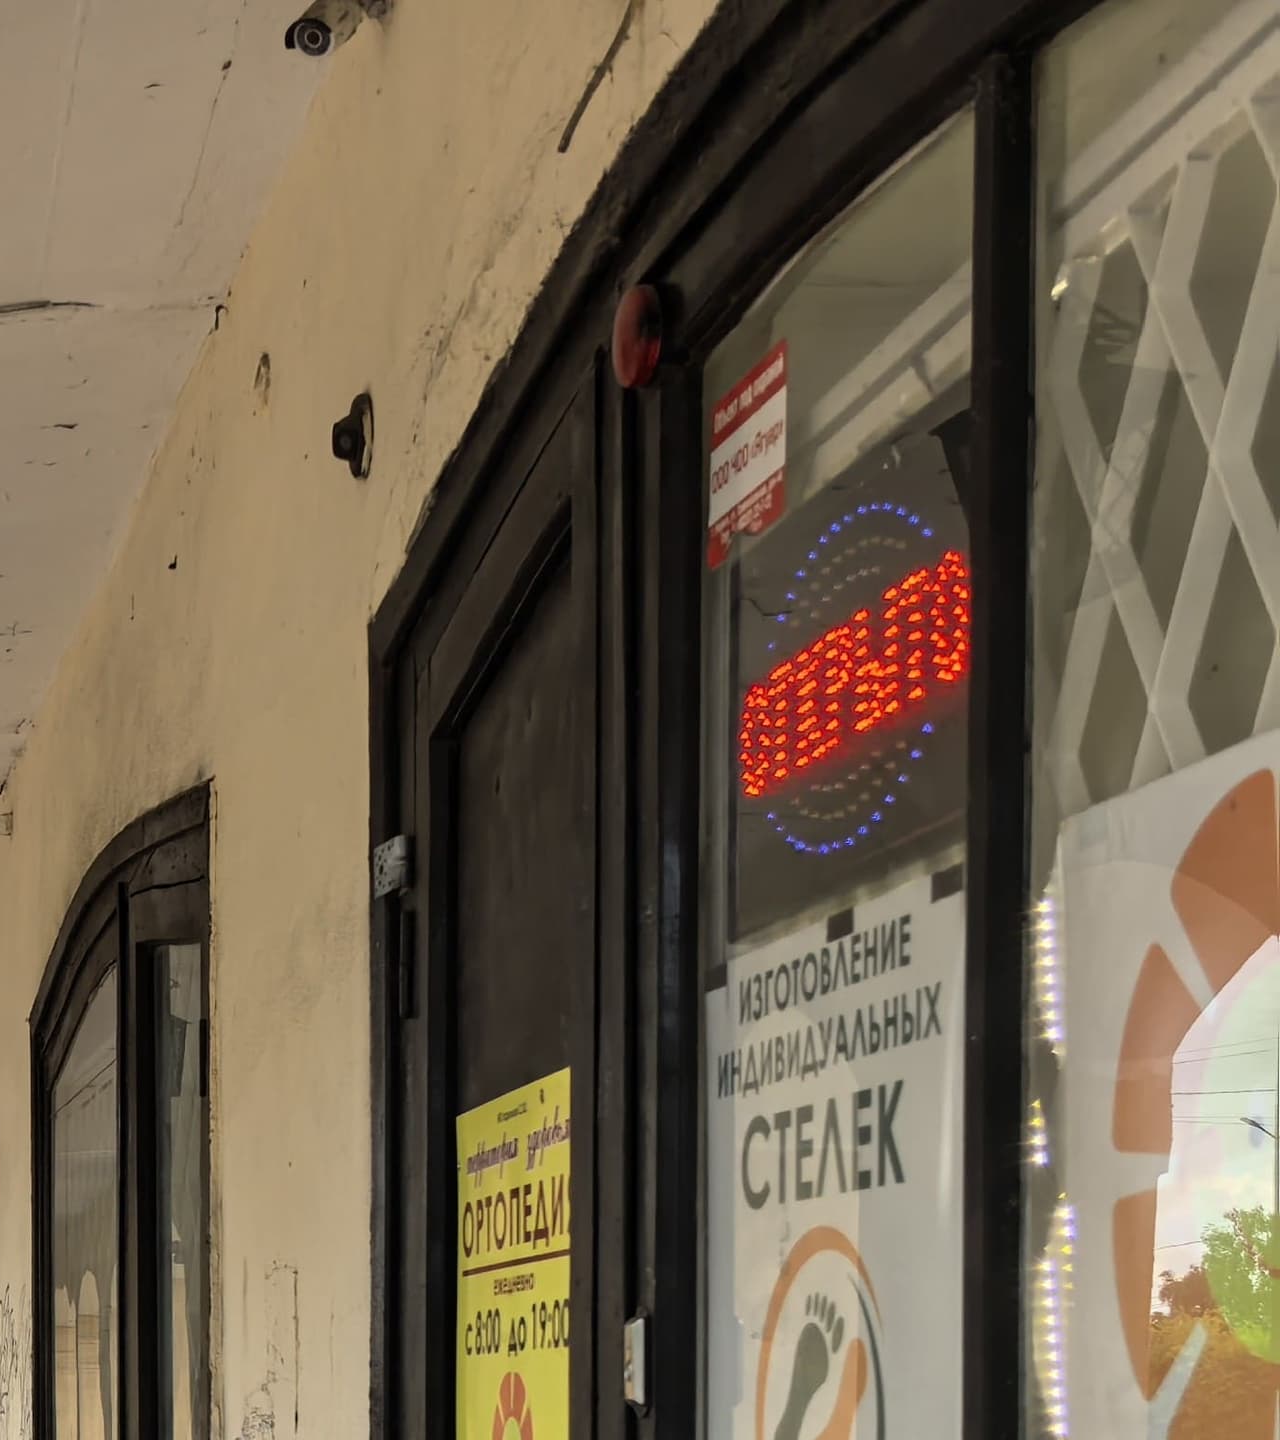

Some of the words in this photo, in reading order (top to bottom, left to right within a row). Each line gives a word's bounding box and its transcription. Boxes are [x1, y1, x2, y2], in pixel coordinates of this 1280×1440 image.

[739, 913, 912, 1026] ИЗГОТОВЛЕНИЕ
[717, 981, 942, 1099] ИНДИВИДУАЛЬНЫХ
[742, 1079, 905, 1210] СТЕЛЕК
[462, 1173, 570, 1259] ОРТОПЕДИ
[475, 1308, 501, 1356] 8:00
[507, 1316, 527, 1357] до
[531, 1298, 570, 1350] 19:00
